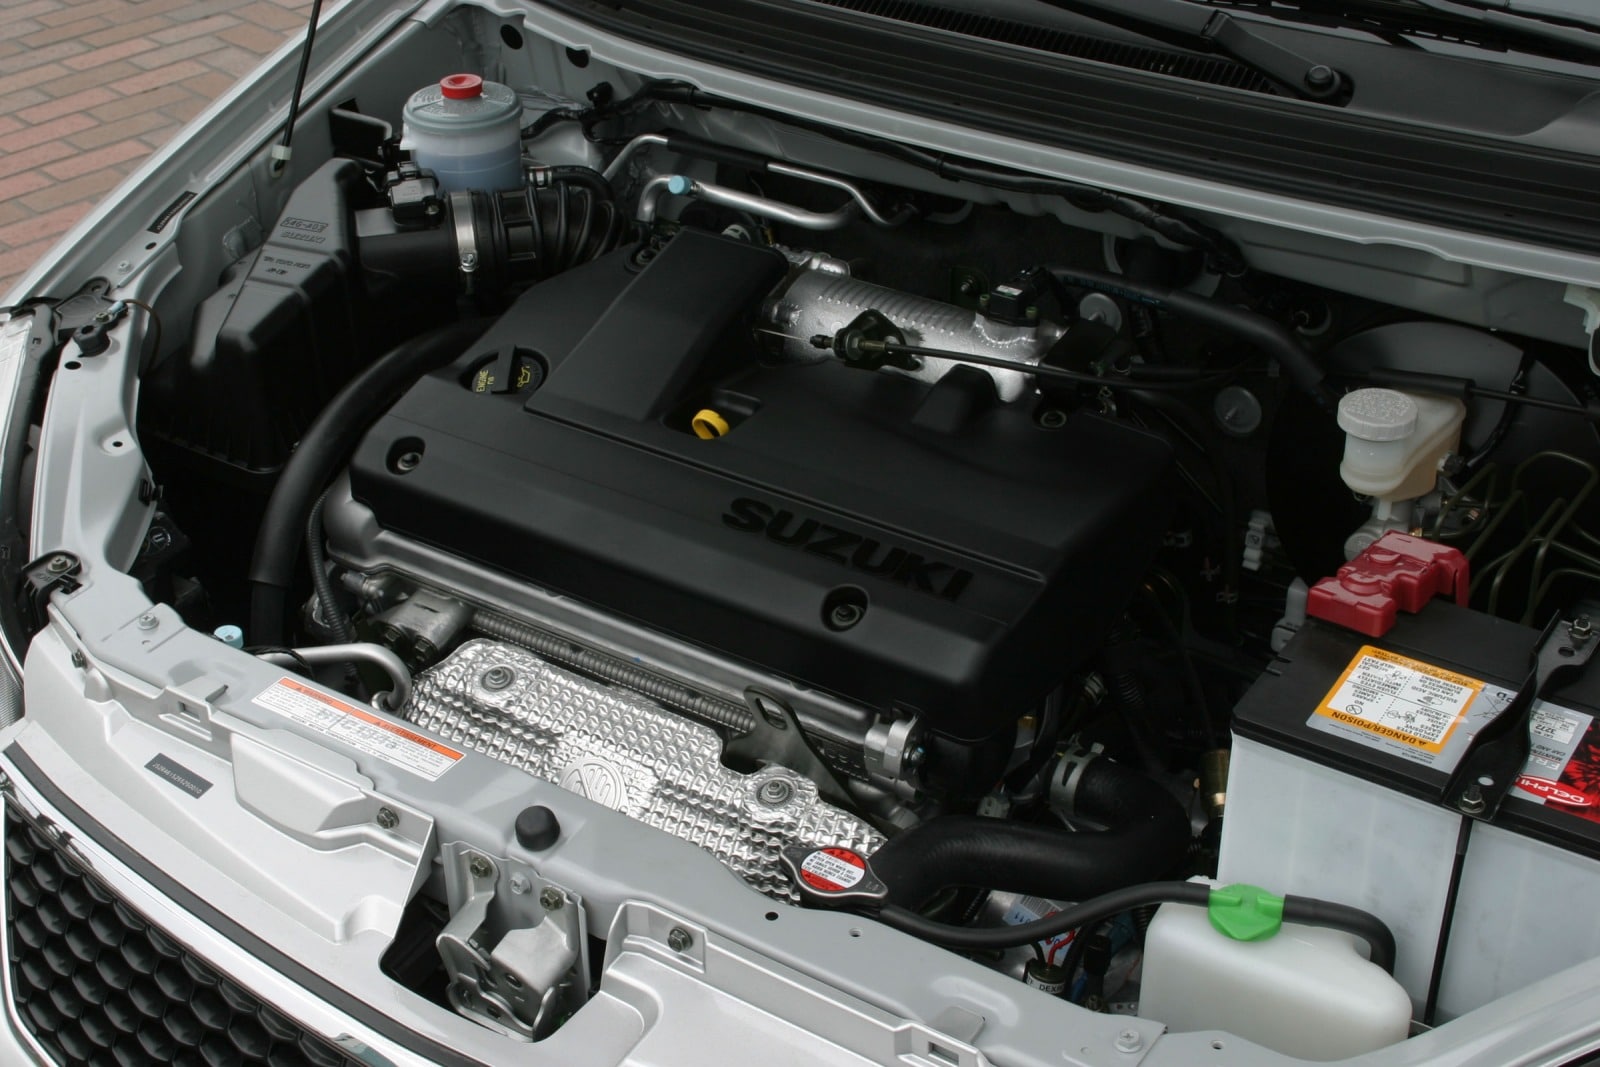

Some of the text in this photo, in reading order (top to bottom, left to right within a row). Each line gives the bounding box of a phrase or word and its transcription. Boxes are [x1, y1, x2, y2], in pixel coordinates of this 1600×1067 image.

[721, 497, 974, 603] SUZUKI
[1329, 711, 1418, 743] DANGER/POISON
[1535, 723, 1556, 735] 3272
[1521, 779, 1584, 803] DELPHI
